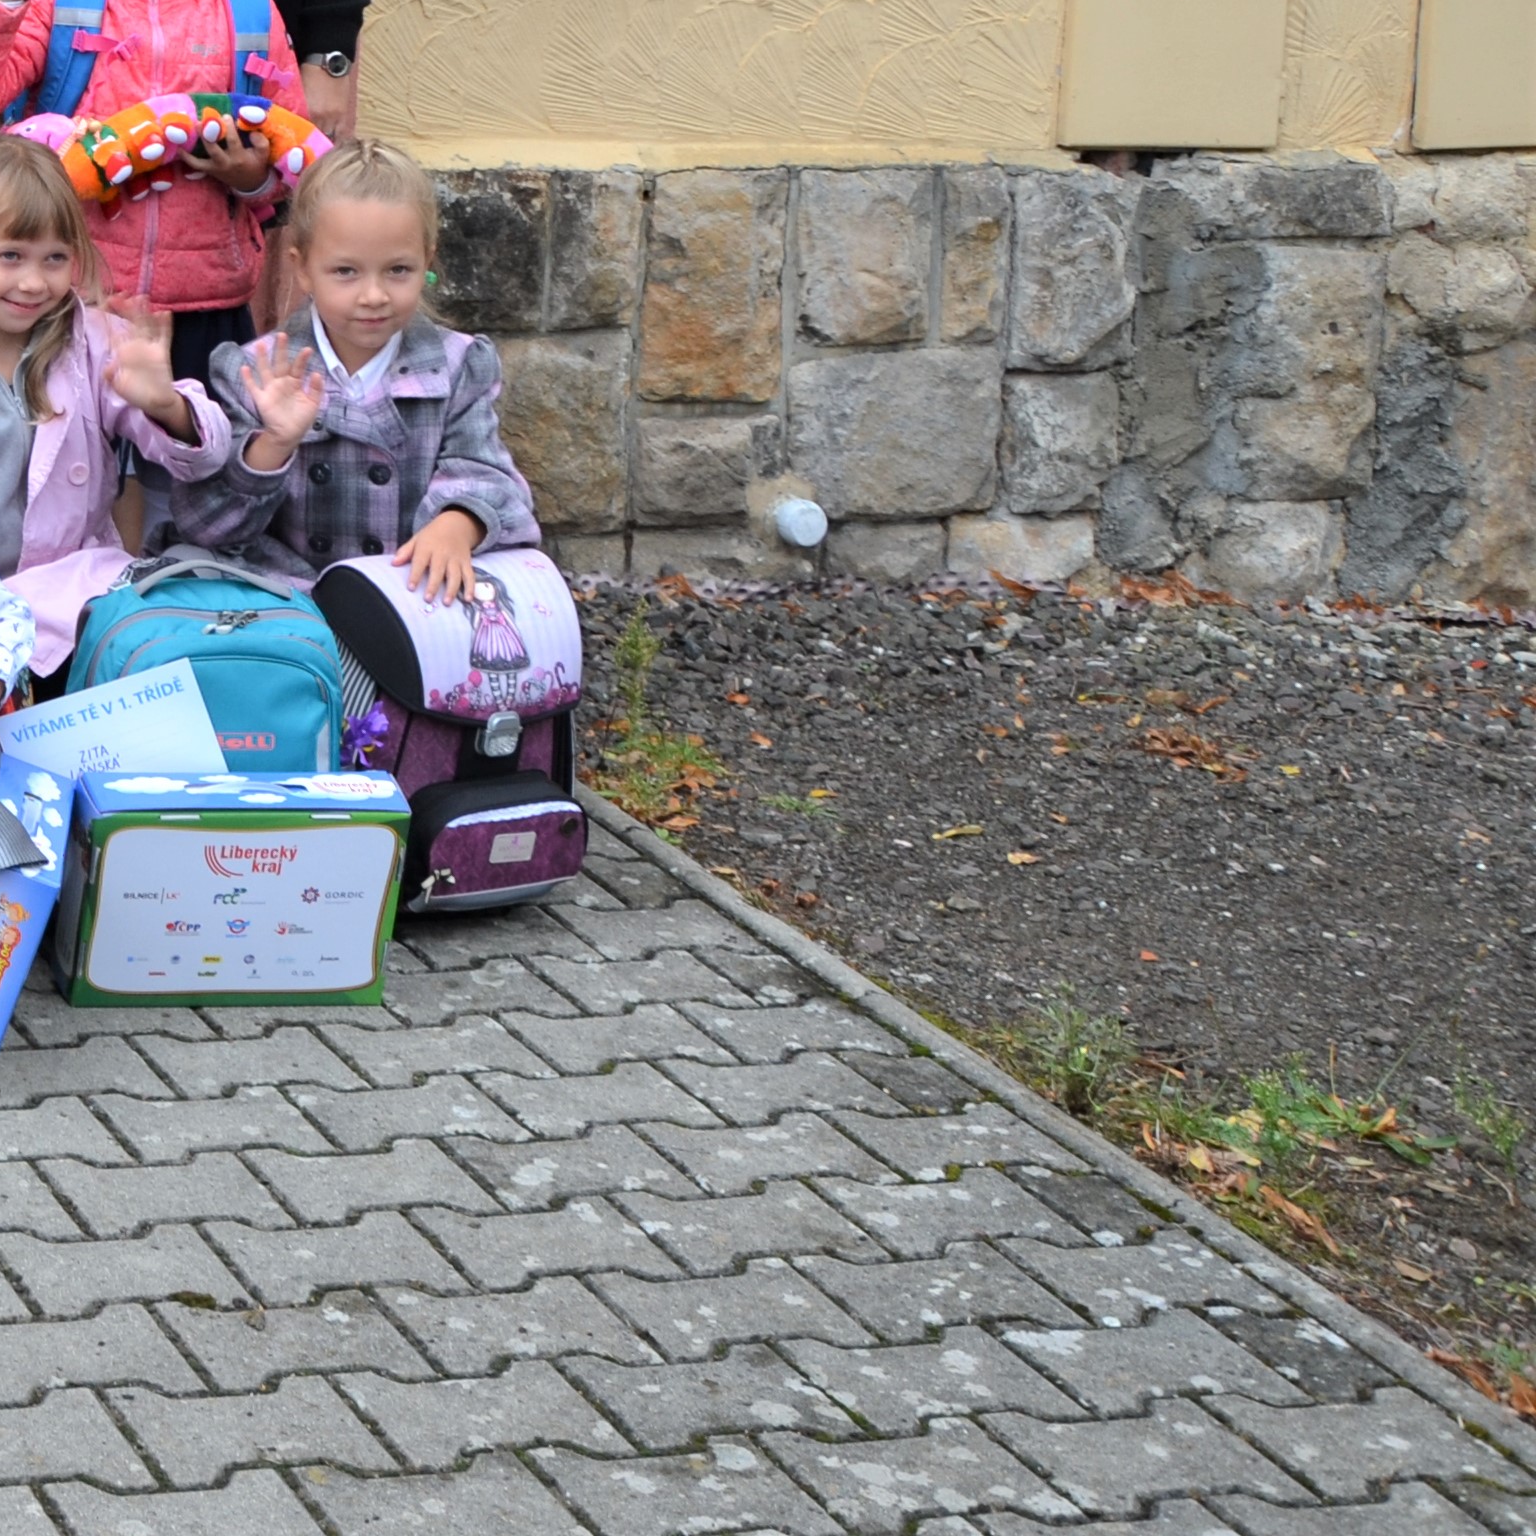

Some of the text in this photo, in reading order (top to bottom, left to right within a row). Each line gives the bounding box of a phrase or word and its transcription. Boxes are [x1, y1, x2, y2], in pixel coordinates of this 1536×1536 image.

[11, 676, 185, 744] VÍTÁME TĚ V 1. TŘÍDĚ
[79, 745, 110, 764] ZITA
[220, 844, 298, 864] Liberecký
[251, 860, 283, 876] kraj
[325, 891, 365, 899] GORDIC
